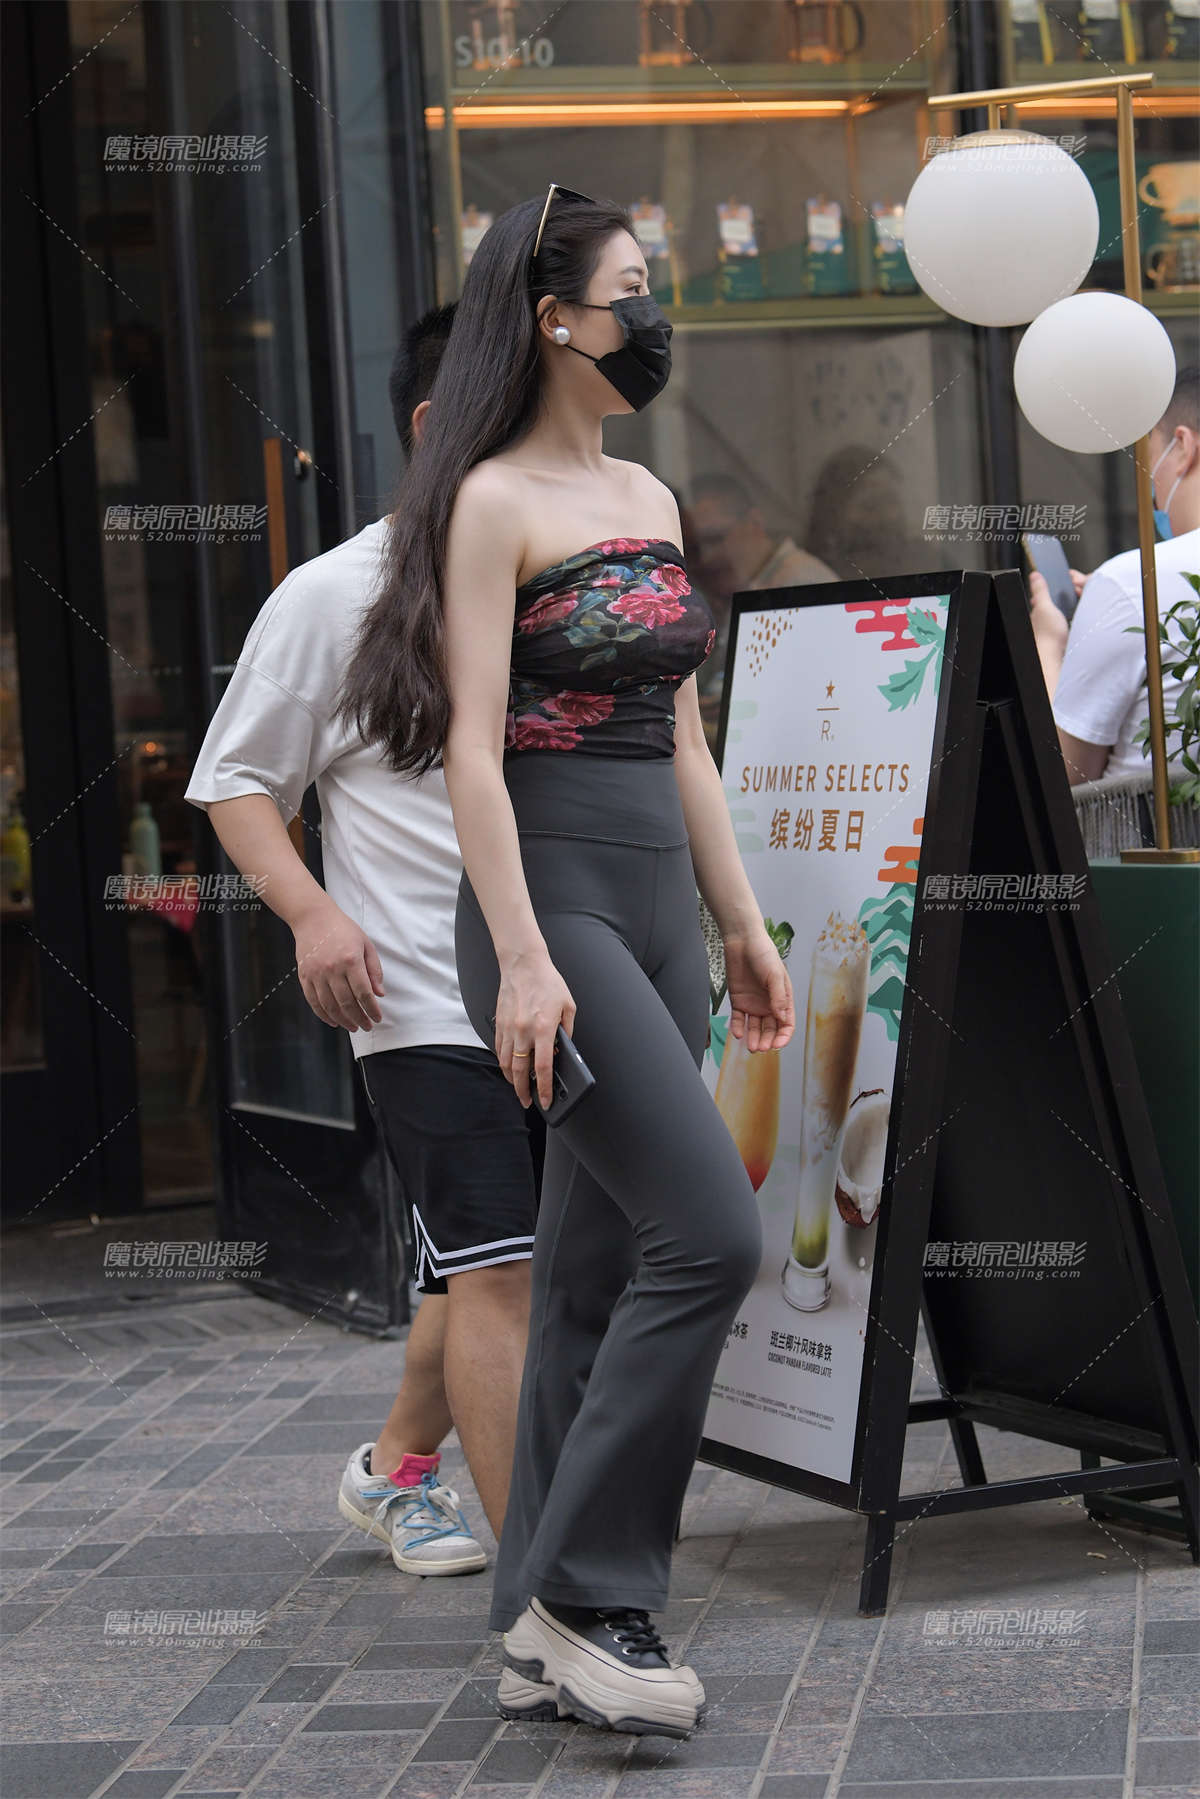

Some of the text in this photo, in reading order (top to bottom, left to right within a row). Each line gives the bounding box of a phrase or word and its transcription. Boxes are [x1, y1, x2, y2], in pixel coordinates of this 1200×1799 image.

[740, 763, 910, 793] SUMMER SELECTS
[769, 808, 865, 852] 缤纷夏日
